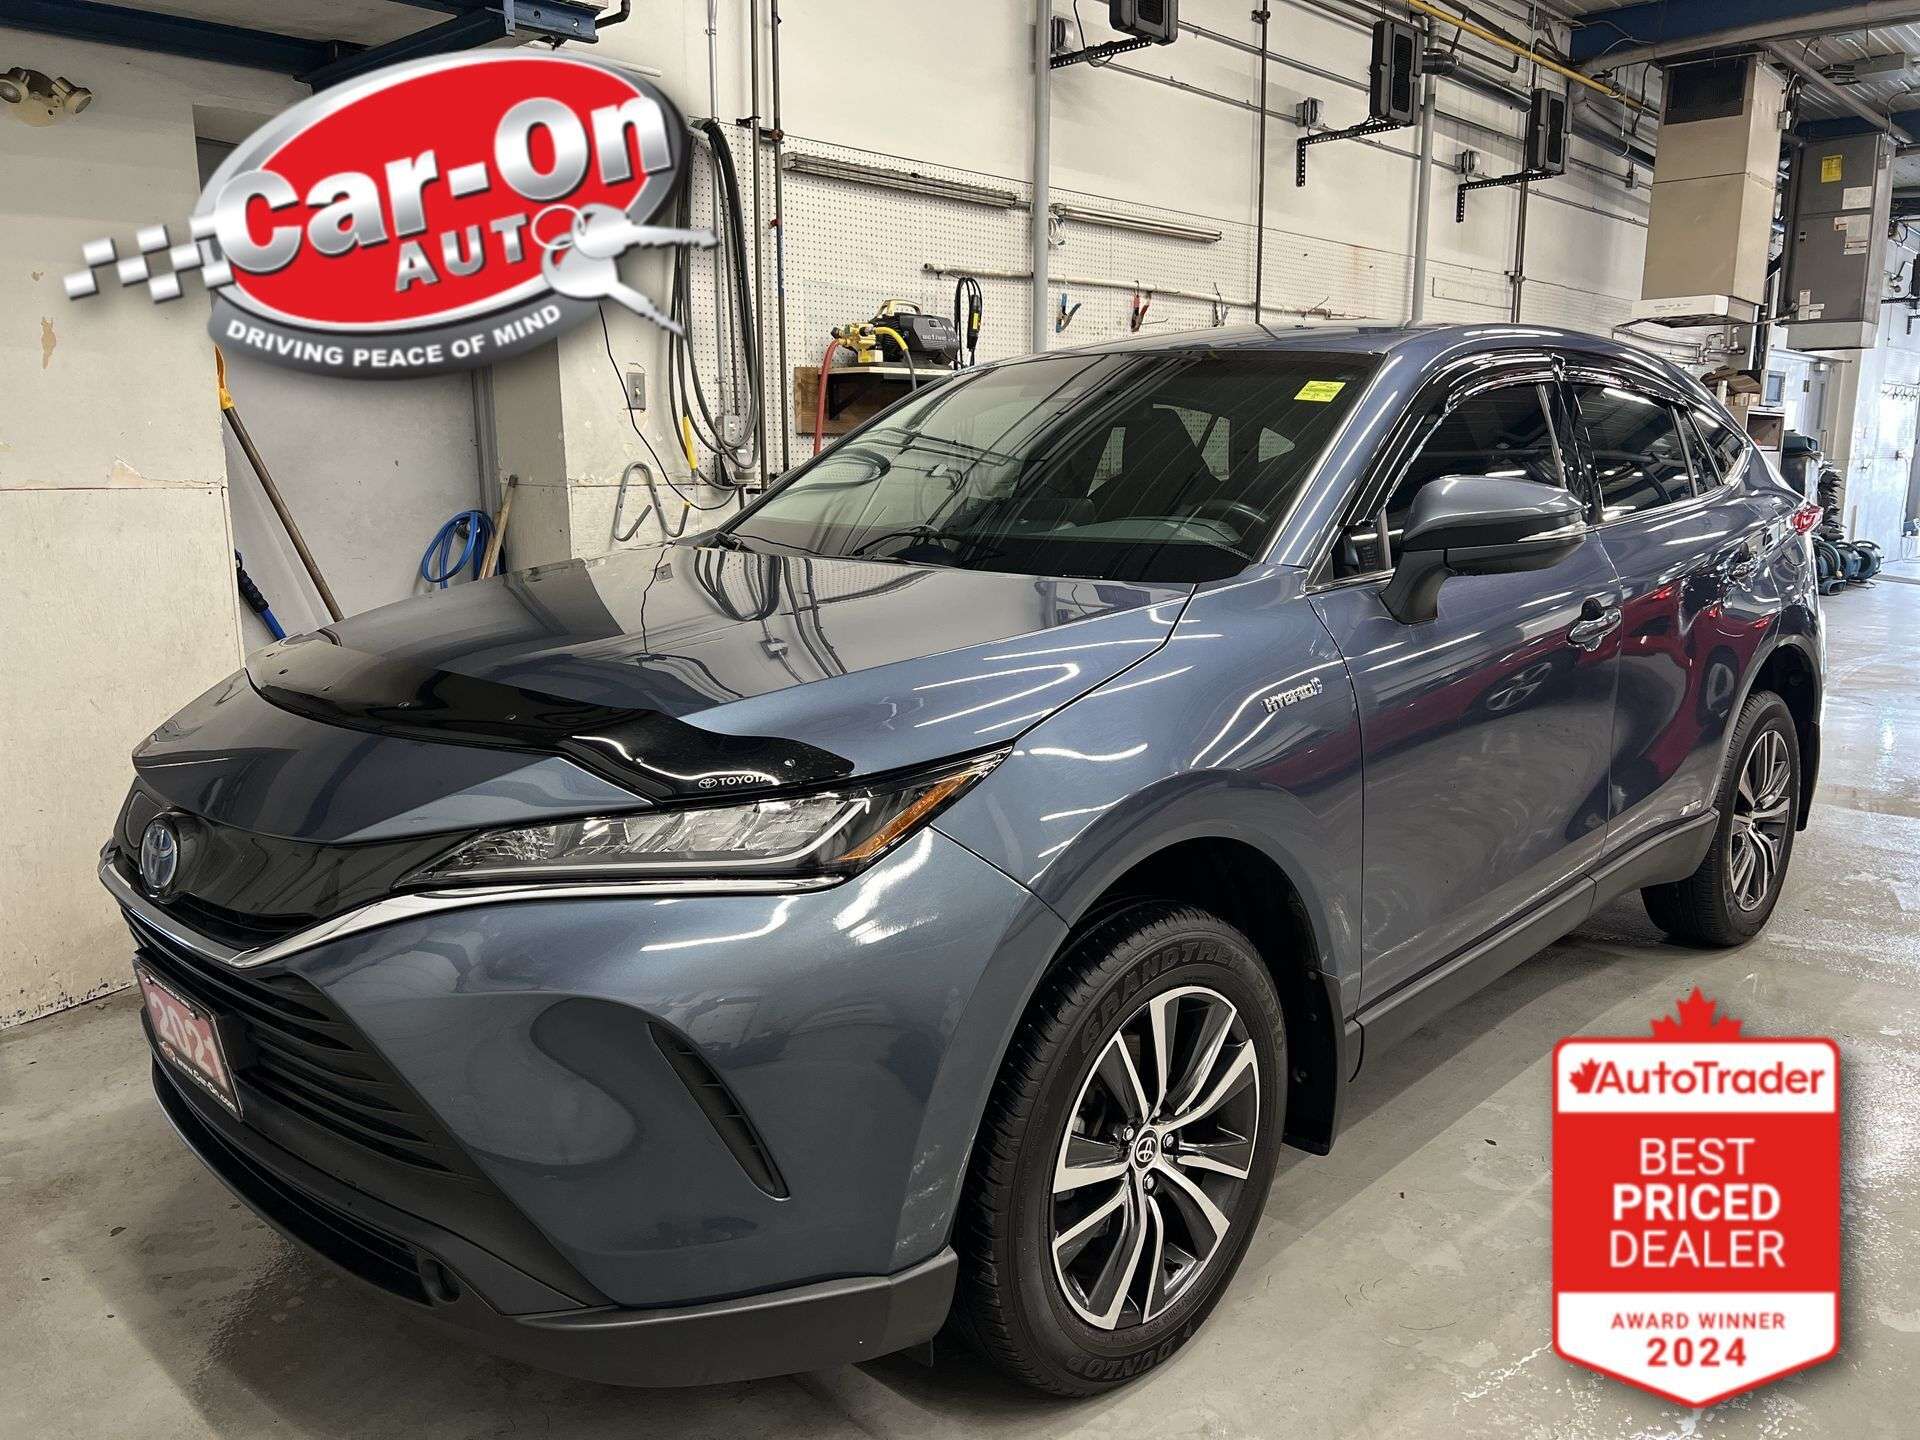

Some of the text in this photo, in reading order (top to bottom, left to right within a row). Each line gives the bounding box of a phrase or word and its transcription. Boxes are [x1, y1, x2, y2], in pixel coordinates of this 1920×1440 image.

[1260, 682, 1316, 714] HYBRID
[719, 775, 770, 786] TOYOTA
[150, 991, 230, 1092] 2021
